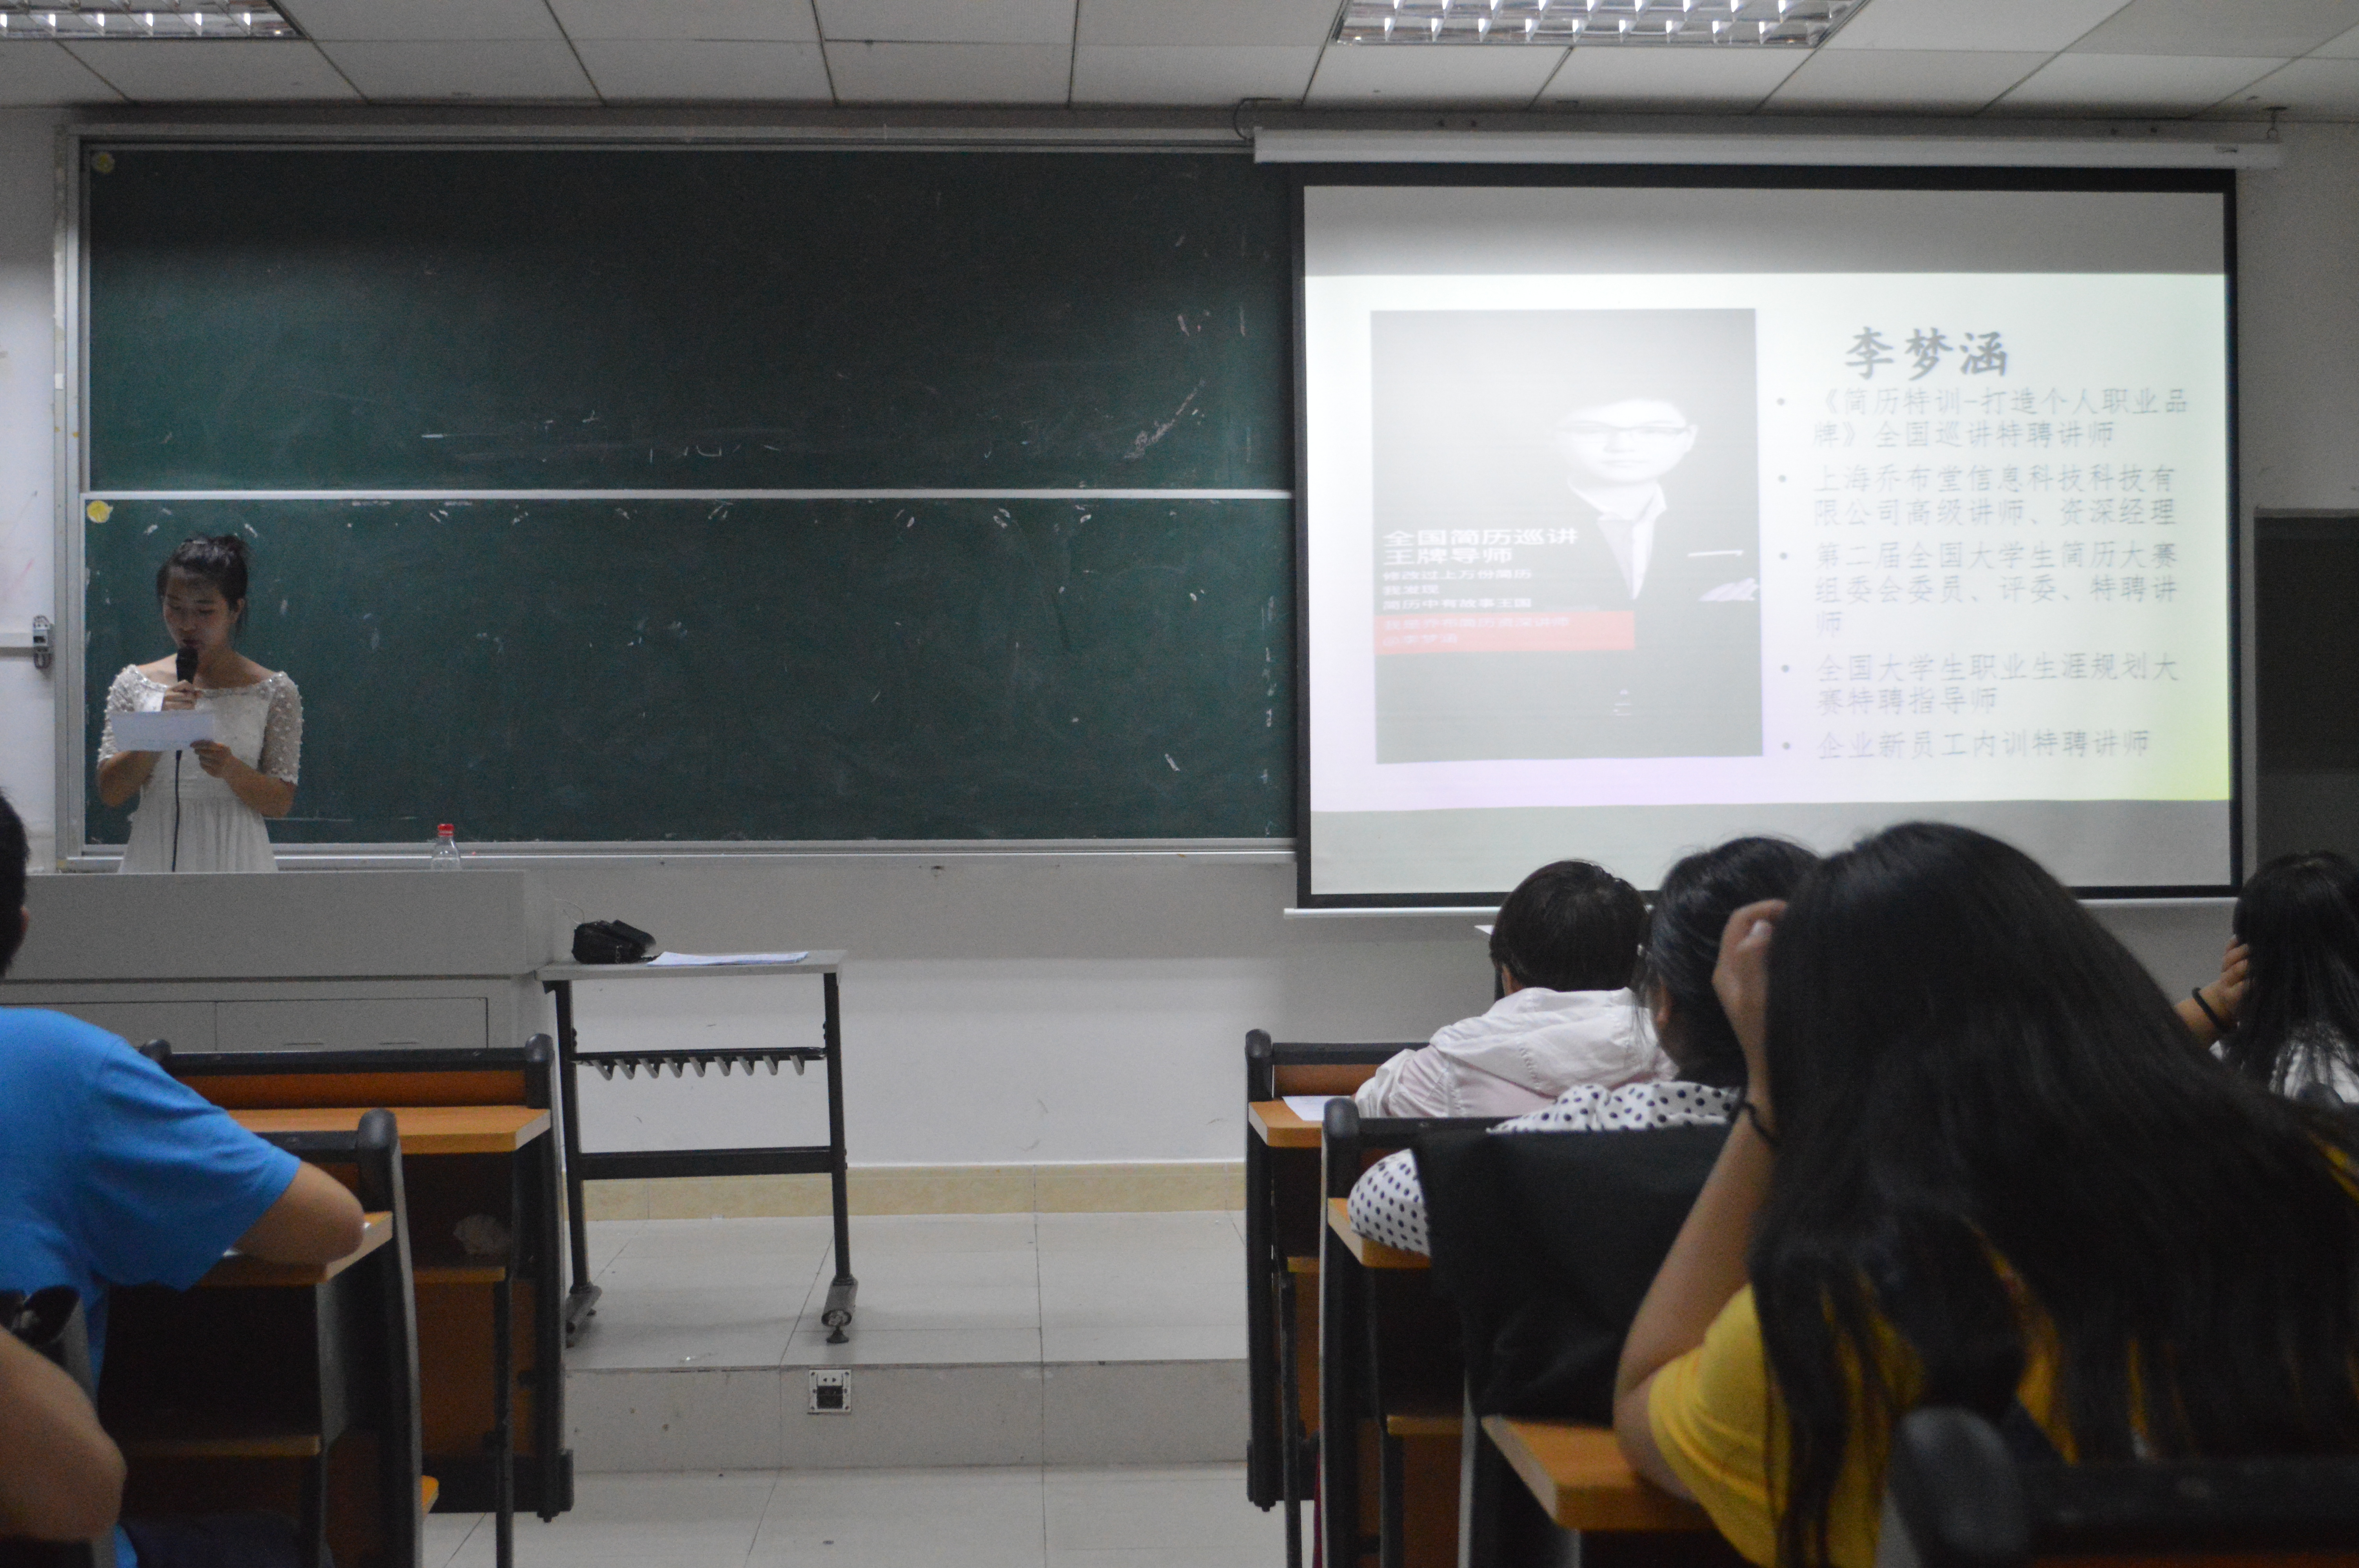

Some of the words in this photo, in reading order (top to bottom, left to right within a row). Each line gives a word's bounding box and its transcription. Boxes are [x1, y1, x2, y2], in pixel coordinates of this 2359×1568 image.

[1844, 325, 2008, 381] 李梦涵
[1383, 528, 1578, 547] 全国简历巡讲
[1383, 548, 1513, 565] 王牌导师
[1816, 652, 2179, 682] 全国大学生职业生涯规划大
[1817, 687, 1998, 716] 赛特聘指导师
[1817, 729, 2150, 760] 企业新员工内训特聘讲师
